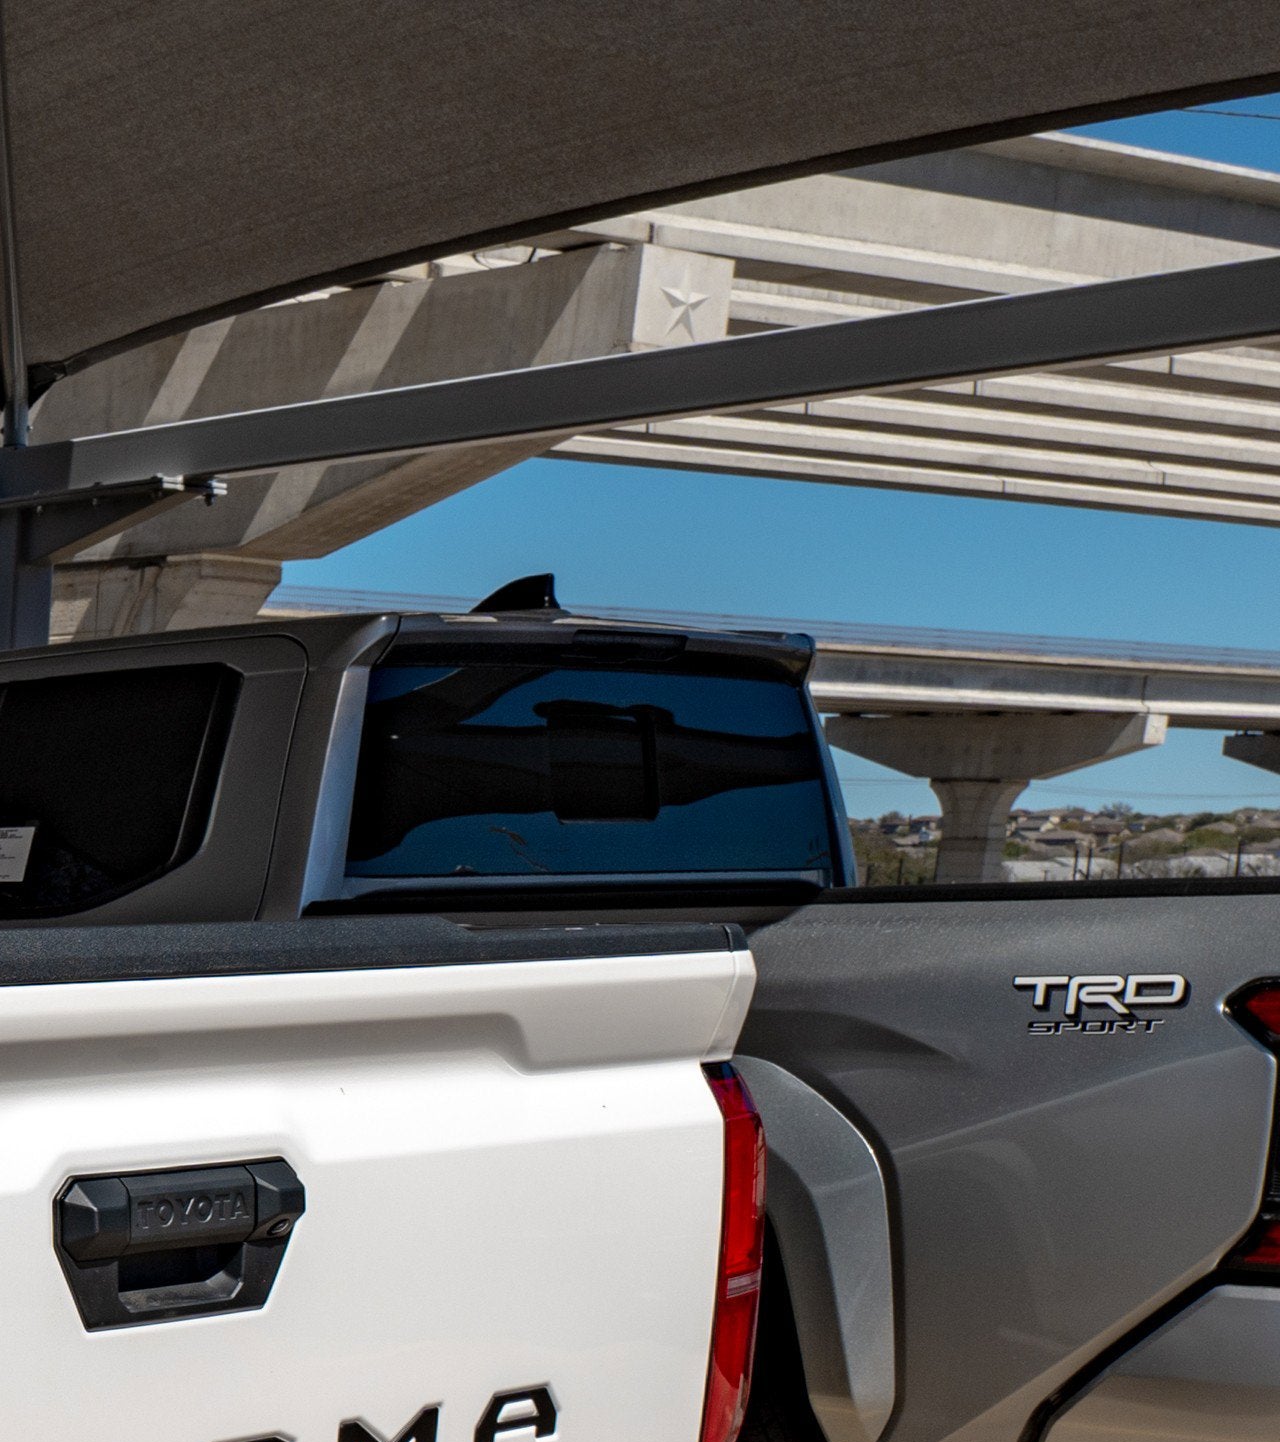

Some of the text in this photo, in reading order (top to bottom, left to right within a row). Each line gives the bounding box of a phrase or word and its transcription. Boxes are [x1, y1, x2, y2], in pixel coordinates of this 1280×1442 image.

[1013, 974, 1189, 1016] TRD
[1027, 1019, 1165, 1036] SPORT
[136, 1192, 251, 1230] TOYOTA
